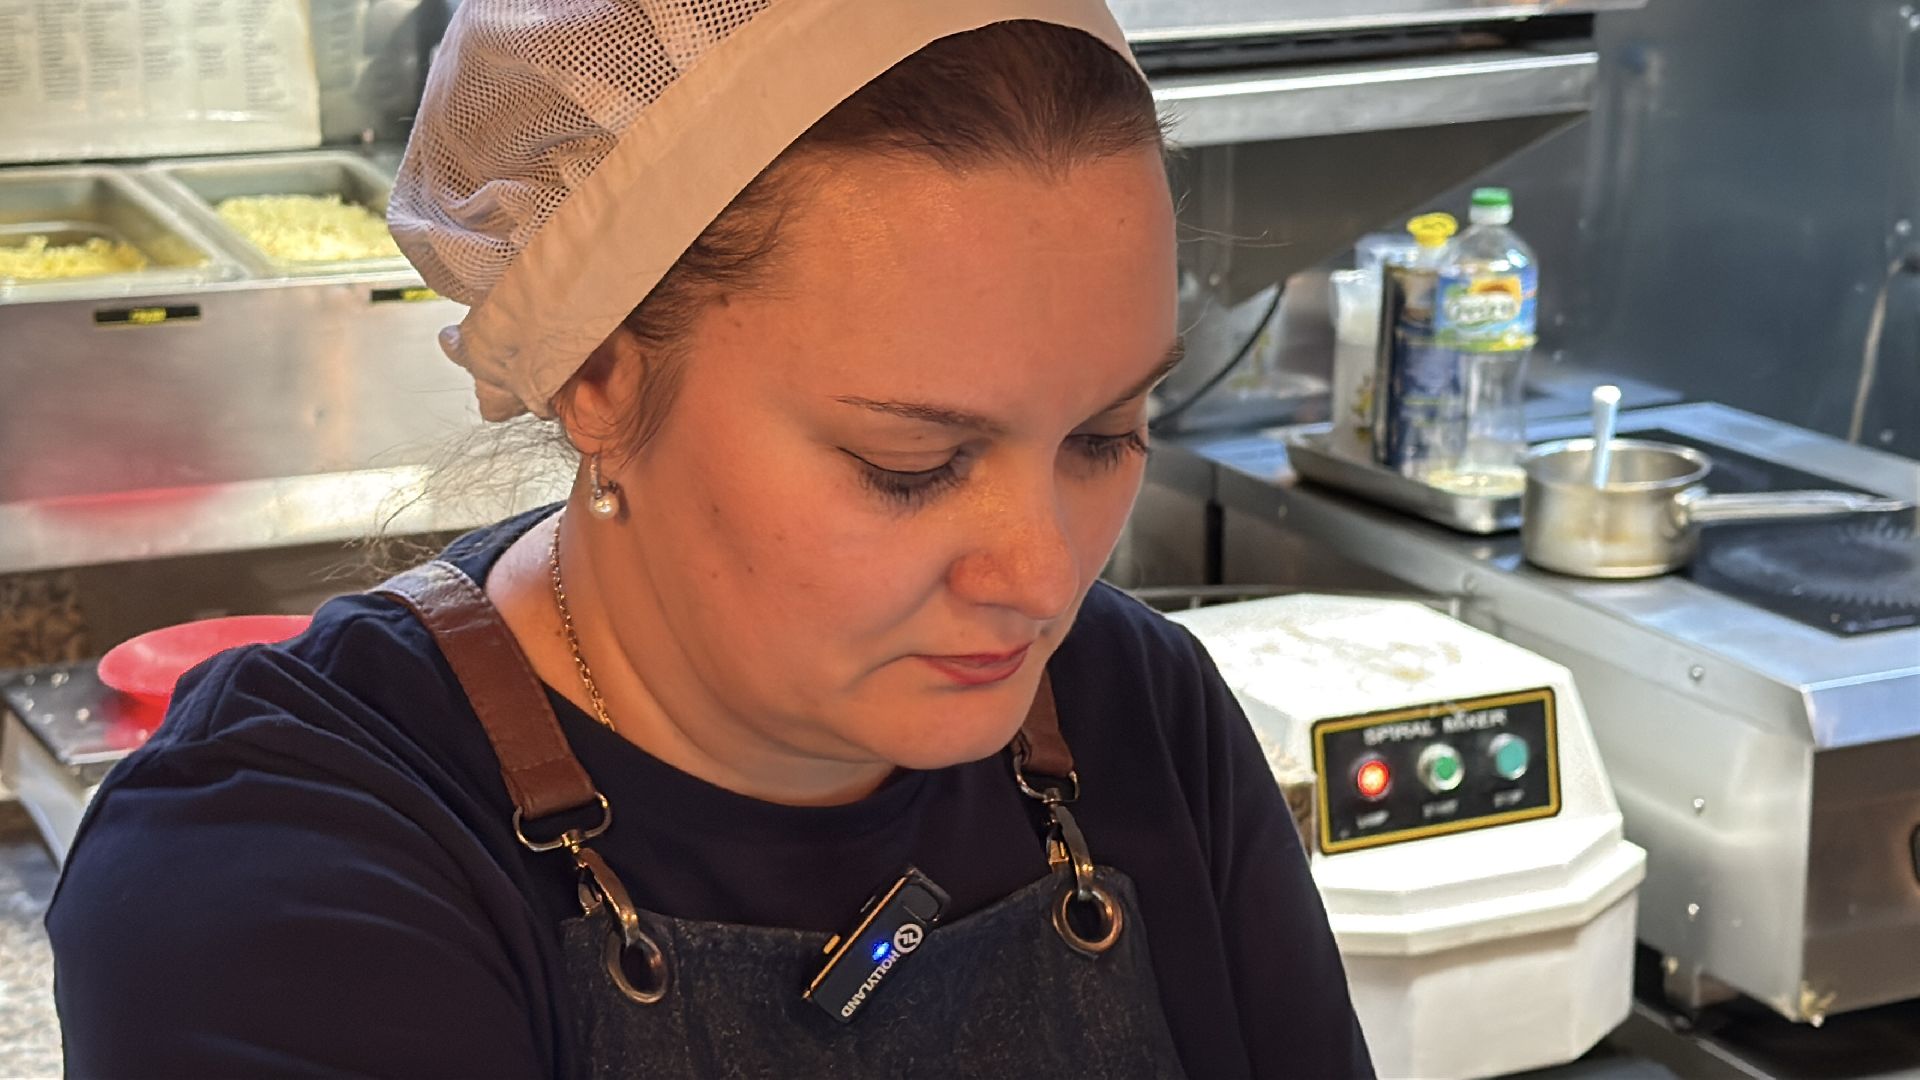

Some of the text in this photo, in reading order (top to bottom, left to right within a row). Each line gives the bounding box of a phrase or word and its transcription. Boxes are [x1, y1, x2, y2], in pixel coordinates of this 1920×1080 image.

[1363, 709, 1507, 746] SPIRAL MIXER
[841, 949, 901, 1017] HOLLYLAND
